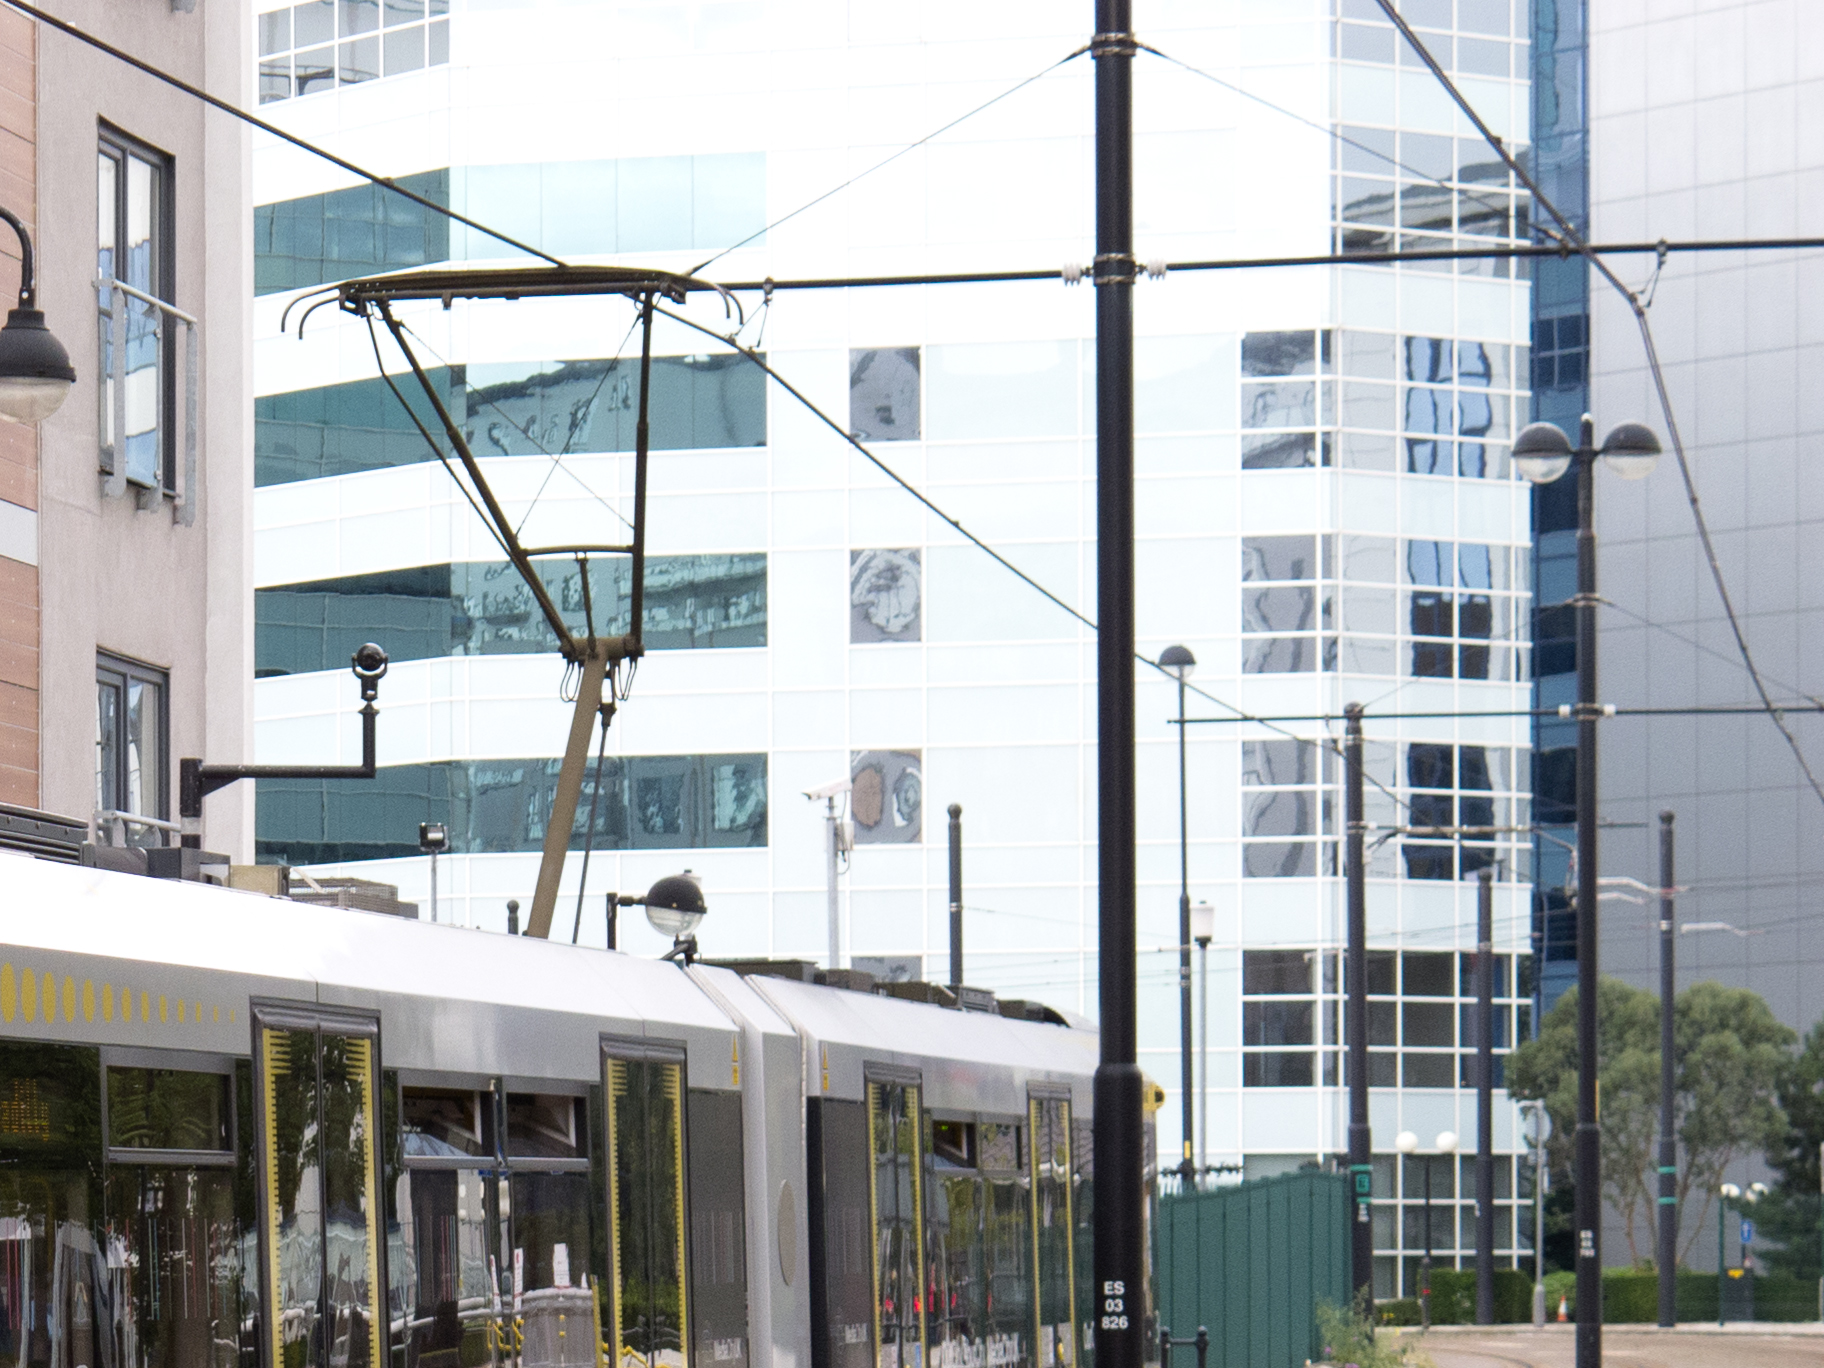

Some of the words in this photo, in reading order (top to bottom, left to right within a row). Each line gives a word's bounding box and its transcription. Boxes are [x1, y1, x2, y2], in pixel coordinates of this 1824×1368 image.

[1103, 1280, 1125, 1295] ES
[1105, 1298, 1124, 1312] 03
[1101, 1315, 1129, 1330] 826
